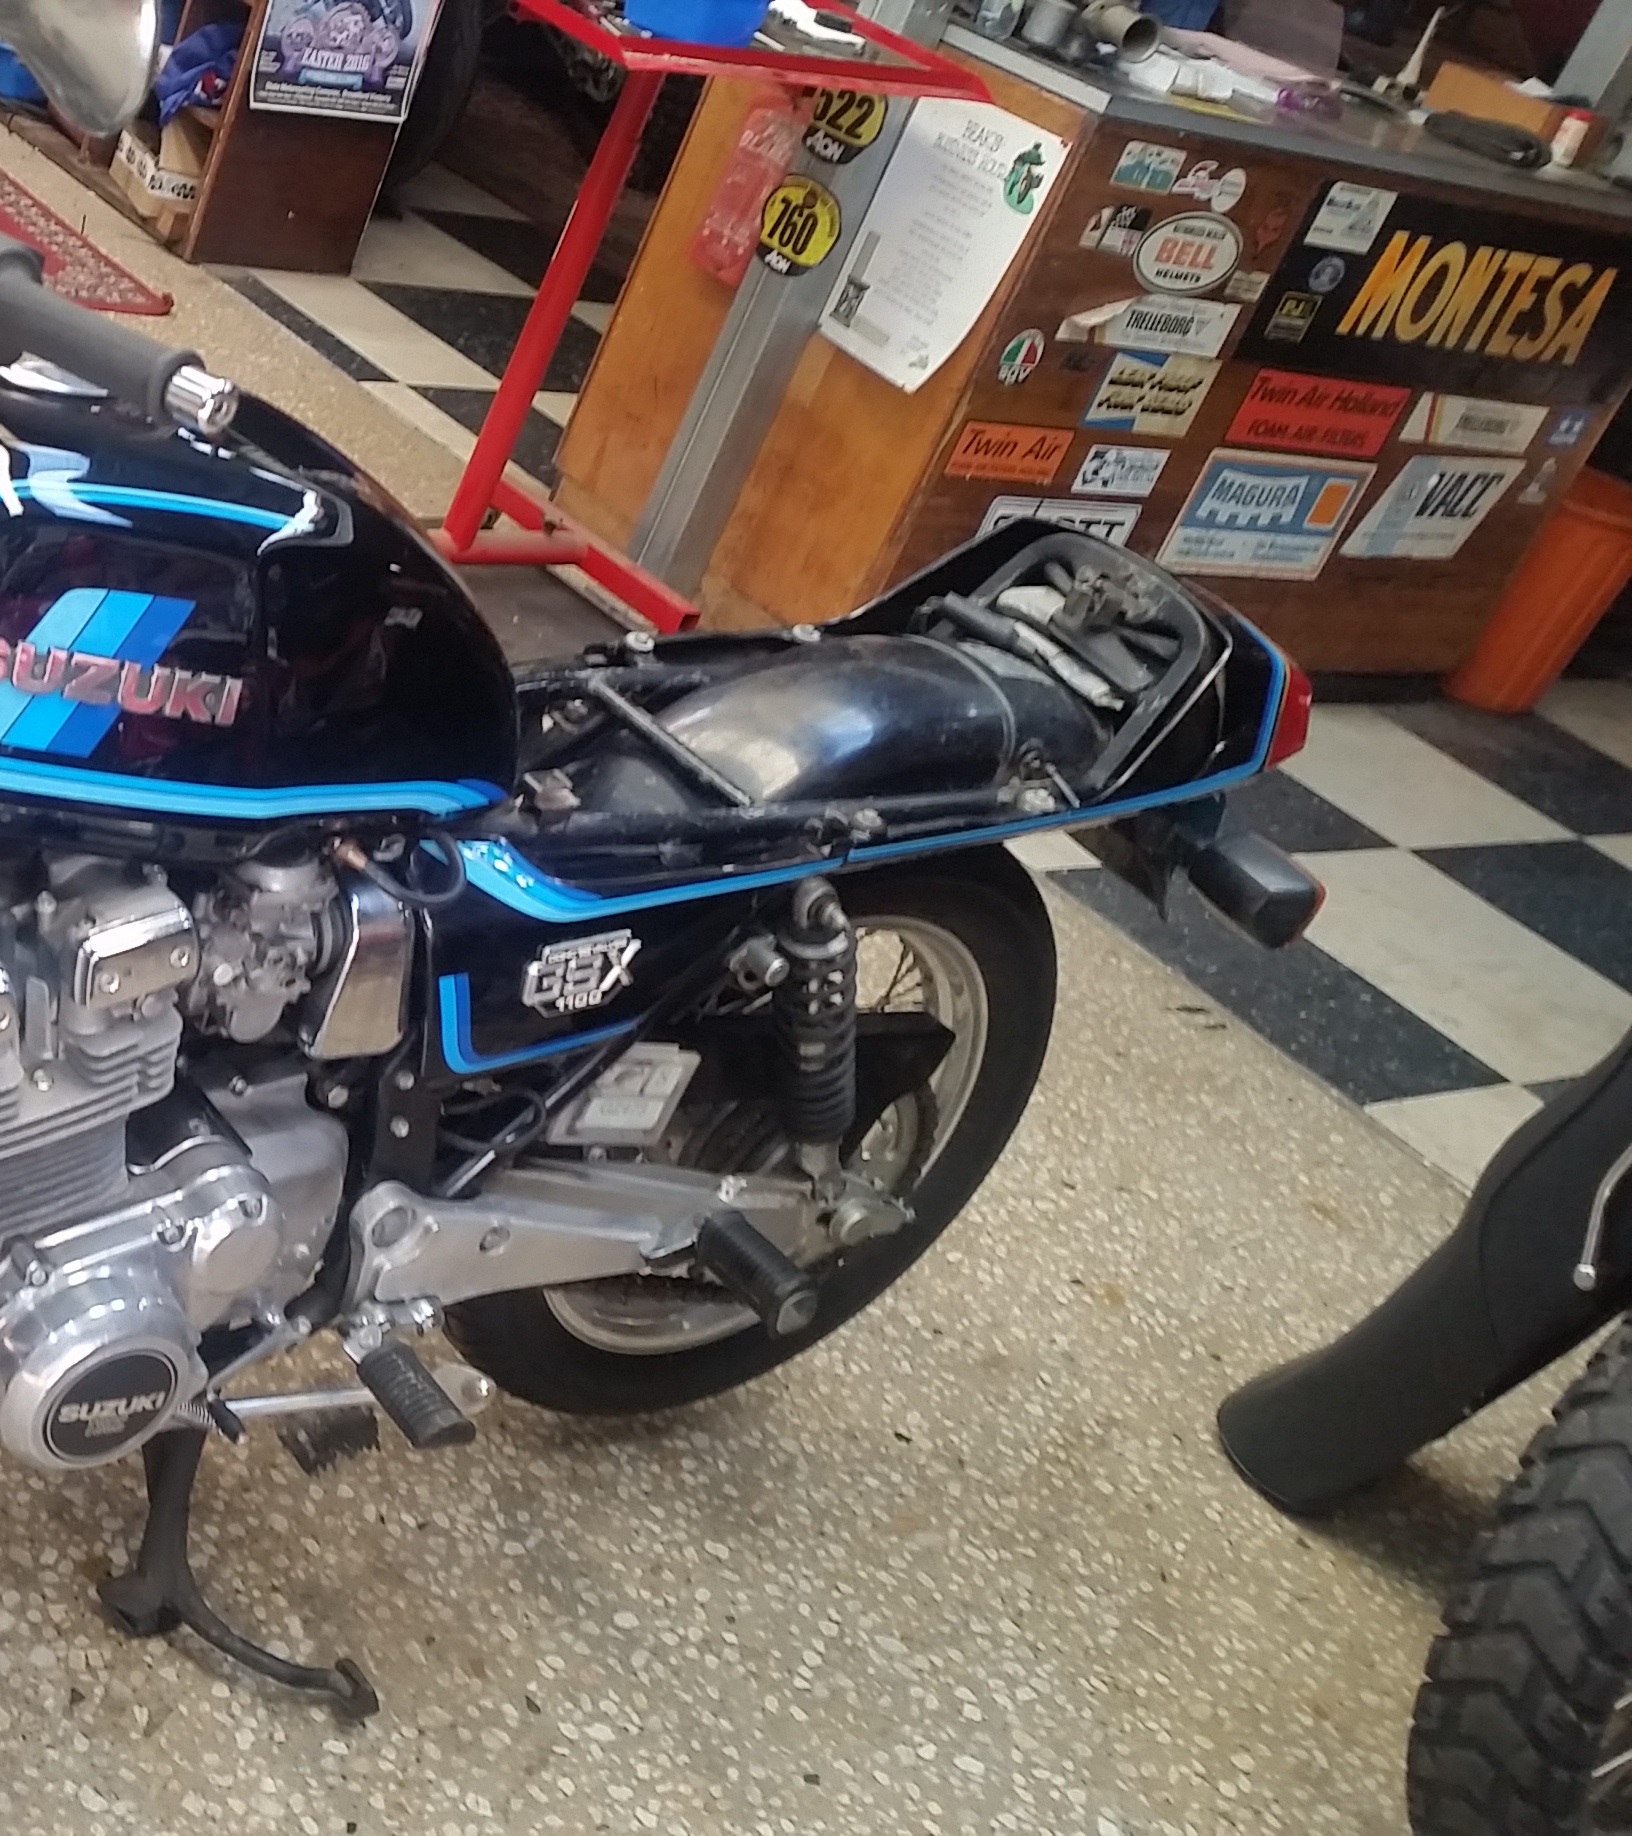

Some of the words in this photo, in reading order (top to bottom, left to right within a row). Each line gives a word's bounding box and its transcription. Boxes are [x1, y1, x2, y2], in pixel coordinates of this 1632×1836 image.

[300, 47, 344, 70] EASTER
[767, 197, 818, 255] 760
[1154, 236, 1218, 271] BELL
[1155, 268, 1201, 284] HELMETS
[1334, 230, 1618, 366] MONTESA
[1125, 309, 1196, 337] TRELLEBORG
[1250, 376, 1298, 403] Twin
[1296, 381, 1330, 409] Air
[1329, 385, 1402, 417] Holland
[962, 428, 1018, 457] Twin
[1022, 434, 1063, 461] Air
[1247, 419, 1289, 438] FOAM
[1215, 477, 1301, 507] MAGURA
[1415, 471, 1506, 518] VACC
[522, 938, 642, 1007] GSX
[555, 989, 603, 1013] 1100
[57, 1390, 167, 1424] SUZUKI
